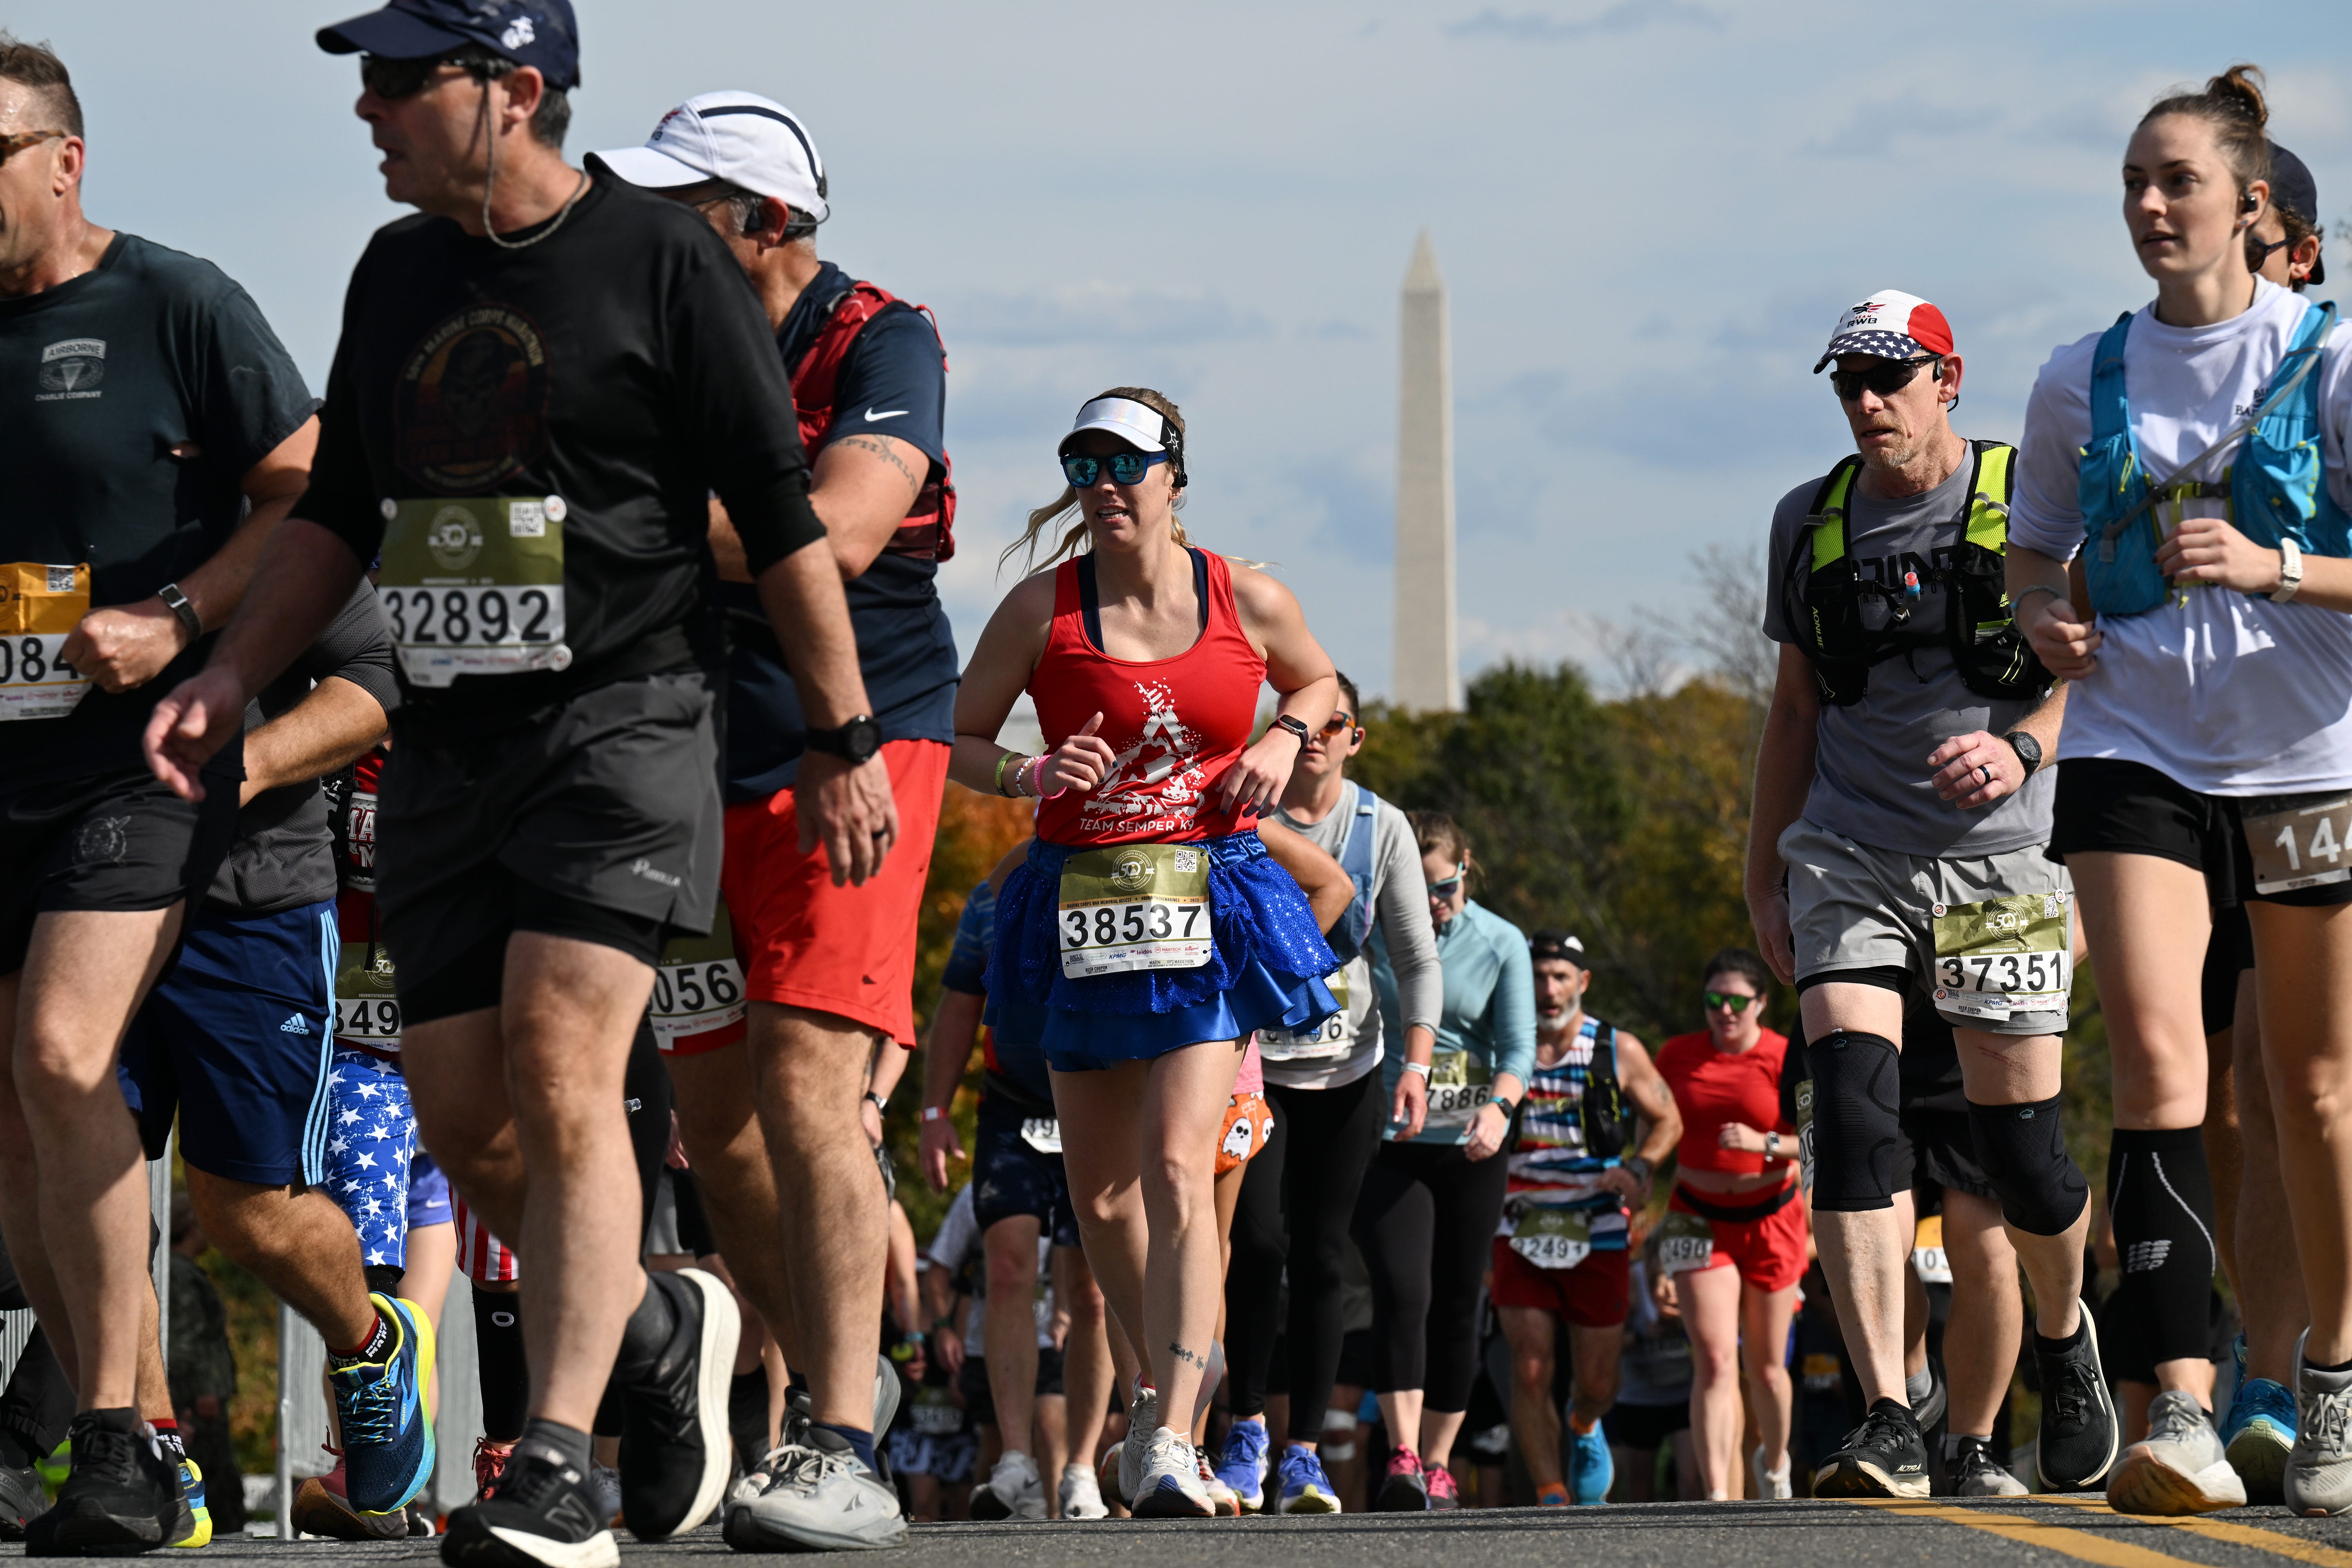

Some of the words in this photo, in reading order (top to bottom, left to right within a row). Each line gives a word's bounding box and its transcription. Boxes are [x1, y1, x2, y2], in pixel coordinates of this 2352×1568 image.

[1847, 318, 1877, 328] RWB
[48, 342, 102, 356] AIRBORNE
[35, 392, 65, 401] CHARLIE
[65, 390, 103, 399] COMPANY
[385, 590, 550, 643] 32892
[1811, 606, 1824, 650] AONIJIE
[1080, 818, 1114, 831] TEAM
[1116, 820, 1175, 832] SEMPER
[1179, 818, 1194, 830] K9
[2275, 817, 2352, 870] 14
[1134, 852, 1151, 867] MARATHON
[1133, 877, 1148, 888] MARATHON
[2009, 903, 2024, 918] MARATHON
[1066, 905, 1201, 947] 38537
[1942, 952, 2061, 992] 37351
[649, 964, 738, 1013] 056
[280, 1024, 309, 1035] adidas
[1897, 1463, 1921, 1472] ALTRA
